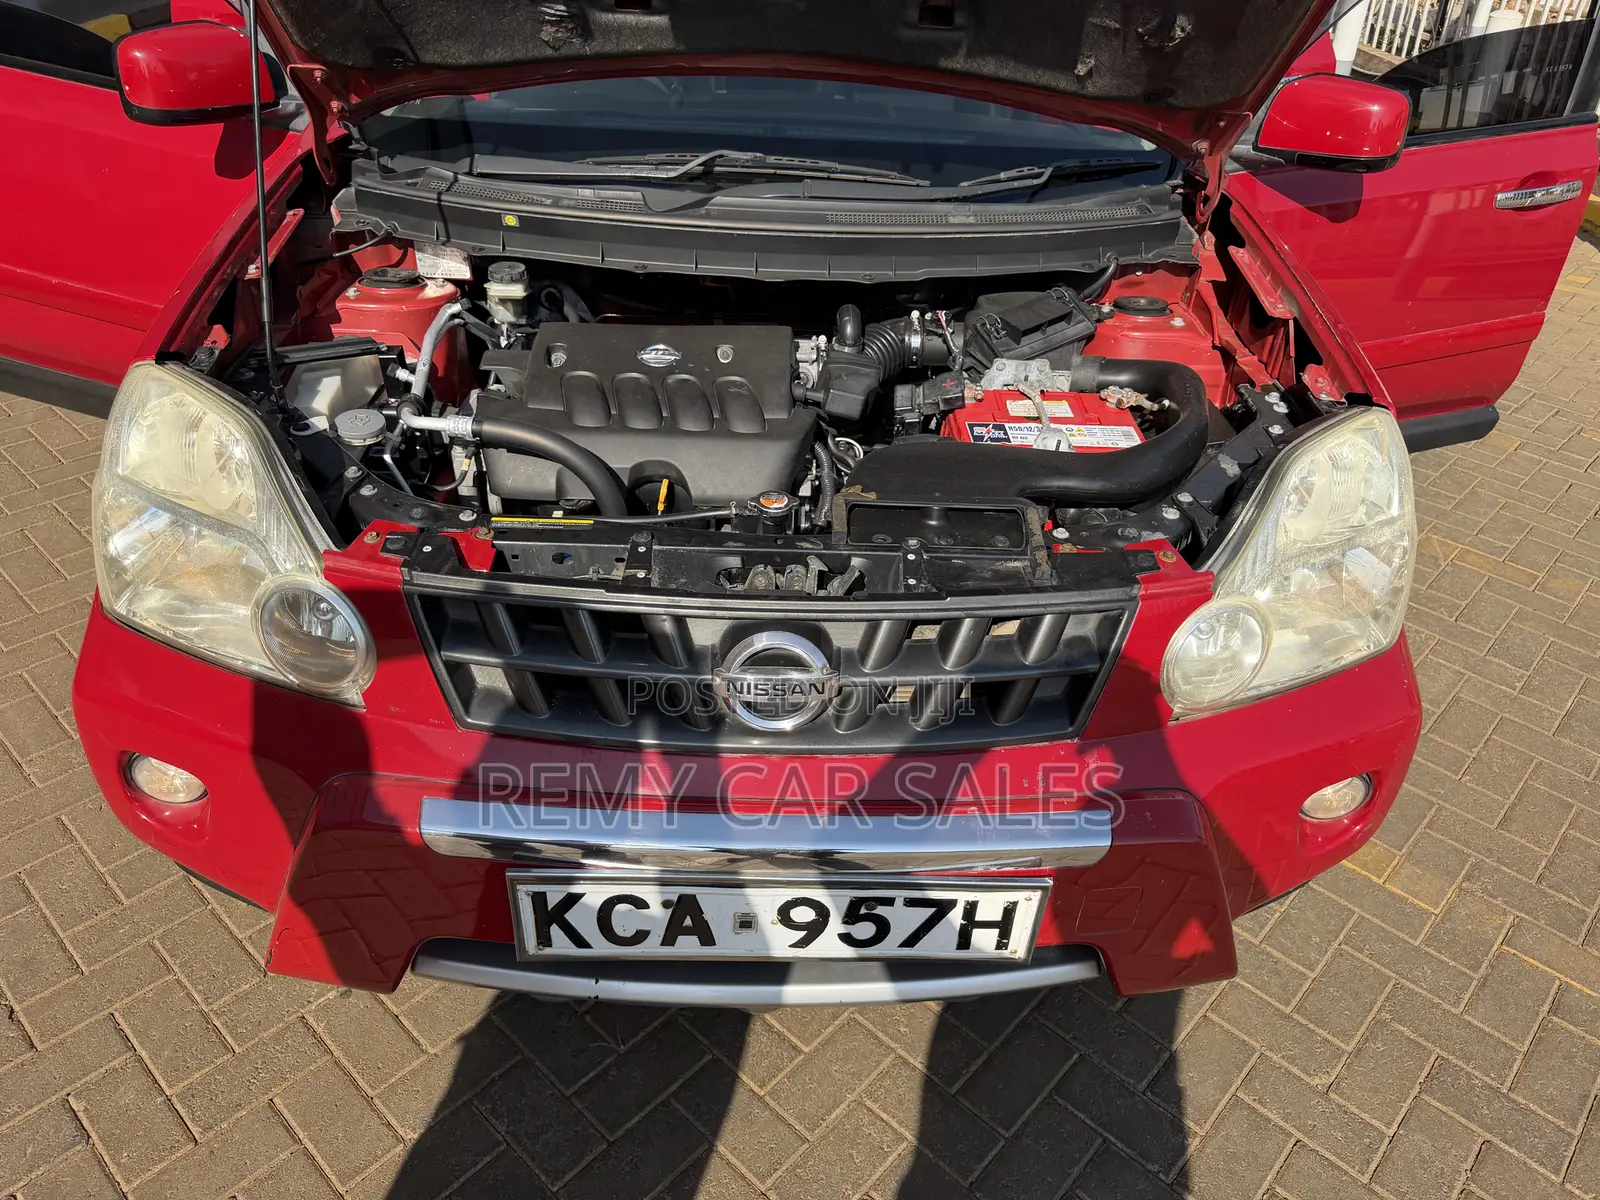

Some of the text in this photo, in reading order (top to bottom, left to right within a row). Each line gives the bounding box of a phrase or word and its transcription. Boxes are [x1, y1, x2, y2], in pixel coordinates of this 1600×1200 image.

[726, 680, 826, 698] NISSAN
[530, 892, 1022, 951] KCA 957H
